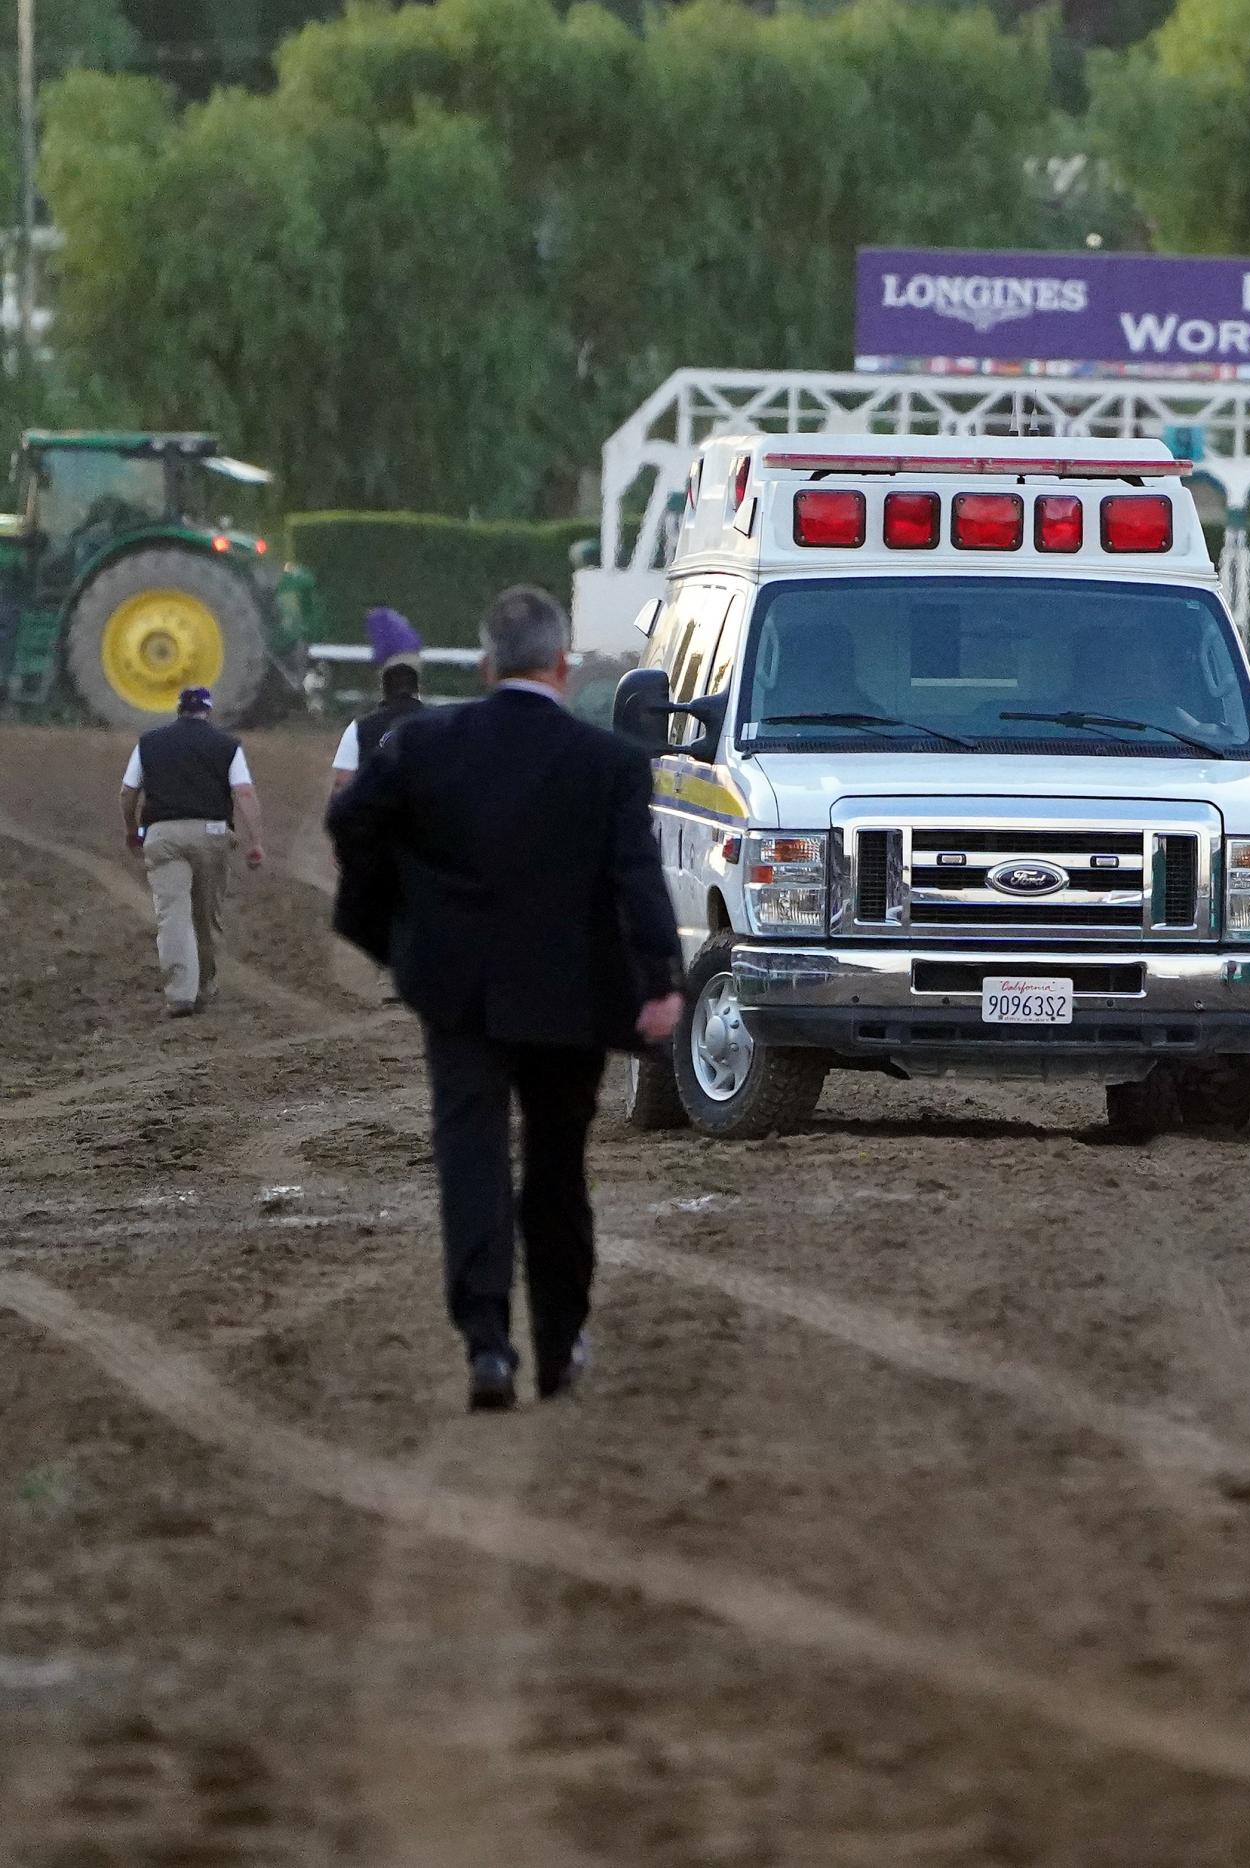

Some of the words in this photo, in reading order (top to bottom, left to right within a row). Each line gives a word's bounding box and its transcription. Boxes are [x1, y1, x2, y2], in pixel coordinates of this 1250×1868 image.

[882, 273, 1089, 313] LONGINES
[1010, 870, 1047, 886] Ford
[1001, 980, 1056, 994] California
[988, 995, 1067, 1017] 90963S2
